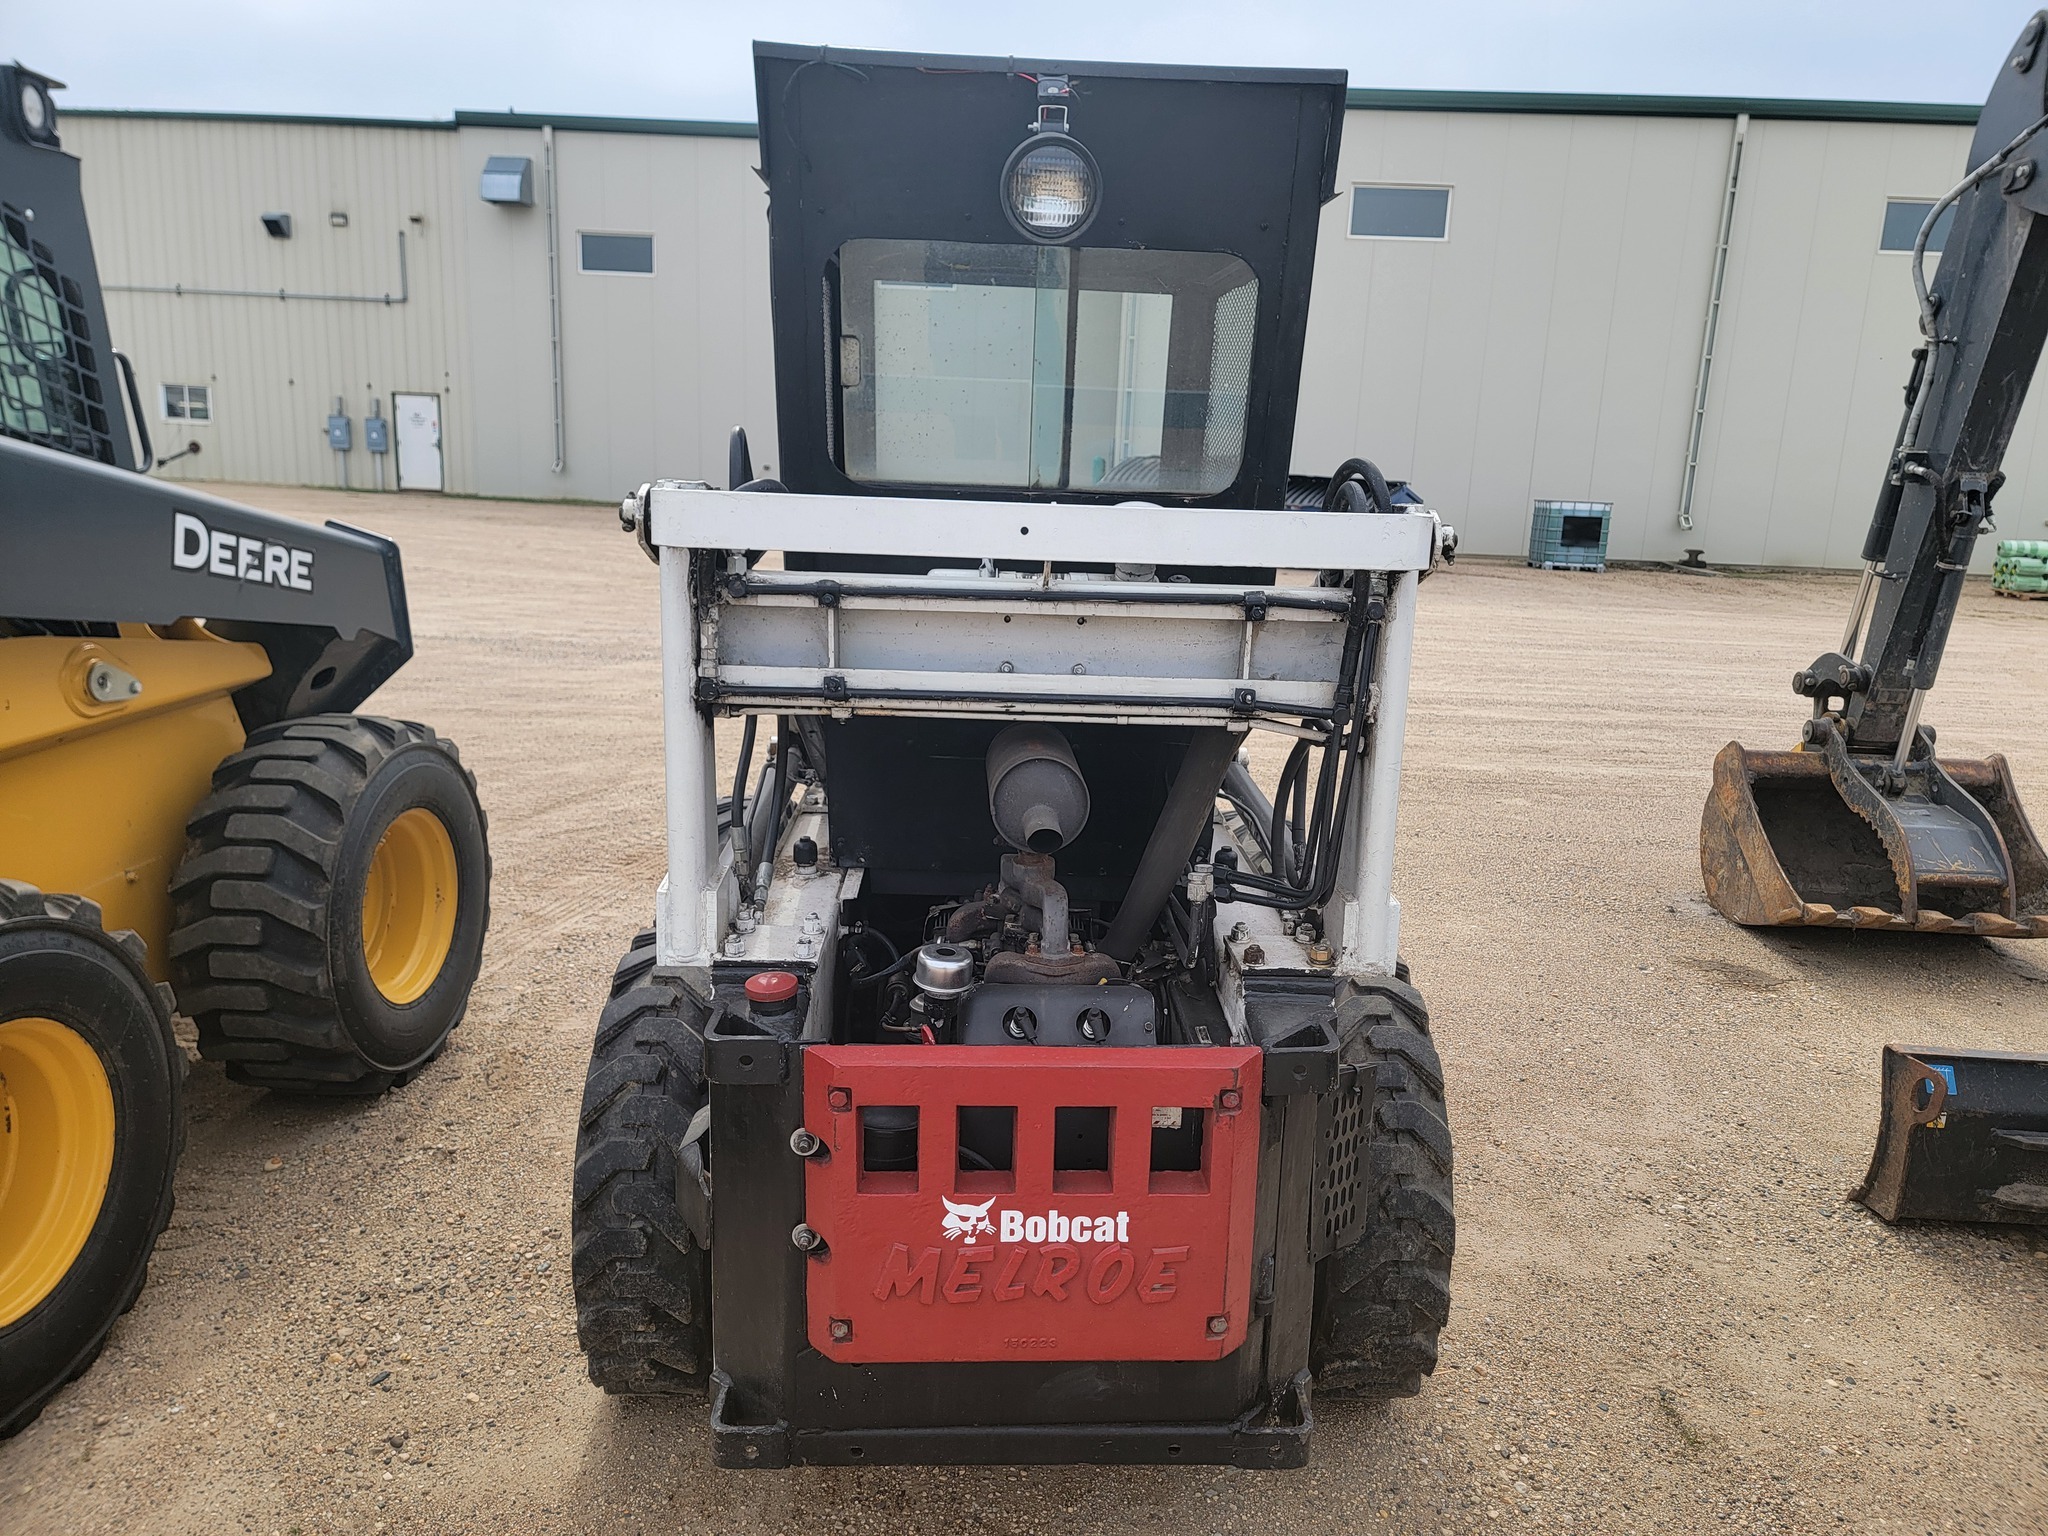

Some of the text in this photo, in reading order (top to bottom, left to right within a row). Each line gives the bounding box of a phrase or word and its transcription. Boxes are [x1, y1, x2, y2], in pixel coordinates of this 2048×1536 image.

[174, 512, 313, 591] DEERE
[1000, 1210, 1130, 1243] Bobcat
[872, 1242, 1191, 1305] MELROE
